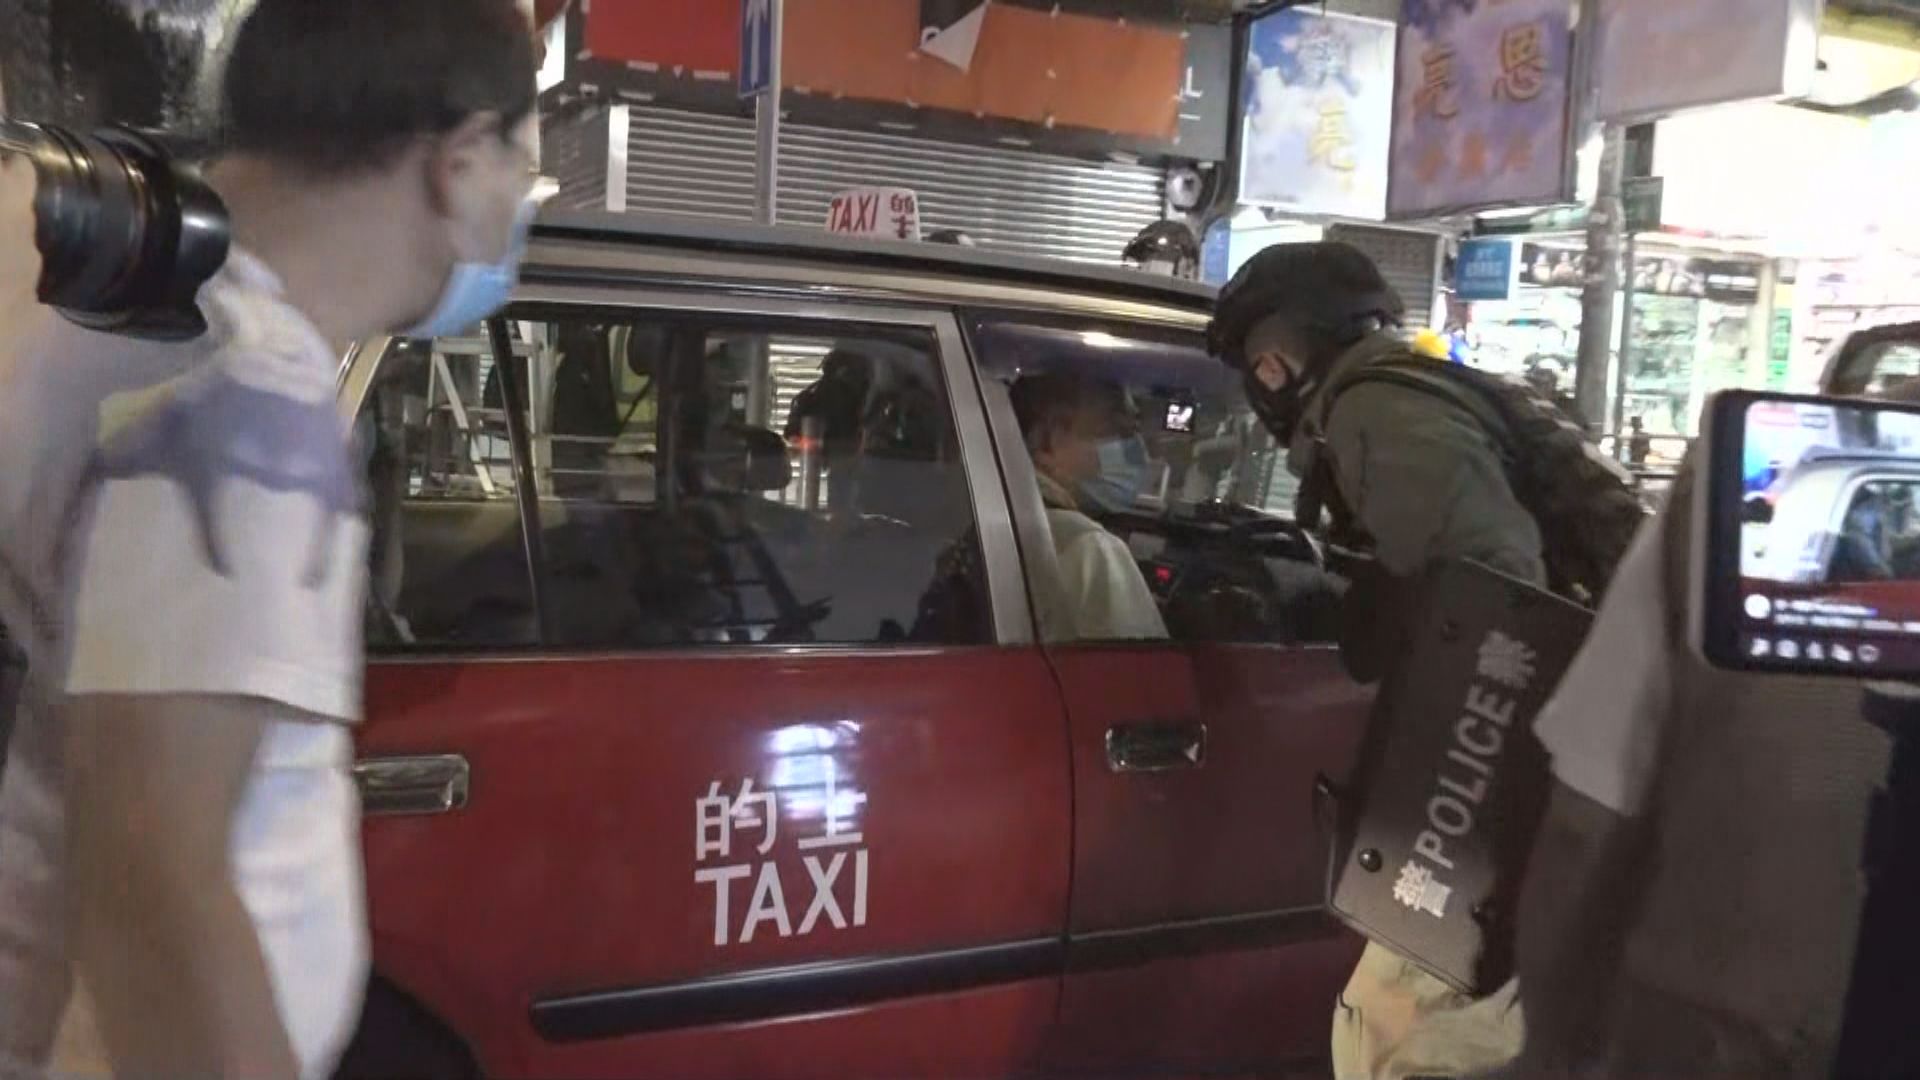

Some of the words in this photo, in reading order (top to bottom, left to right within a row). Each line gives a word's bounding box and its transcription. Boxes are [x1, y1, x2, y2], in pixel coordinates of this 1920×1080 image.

[831, 193, 880, 232] TAXI
[696, 755, 867, 861] 的士
[1414, 684, 1517, 870] POLICE
[695, 848, 868, 945] TAXI
